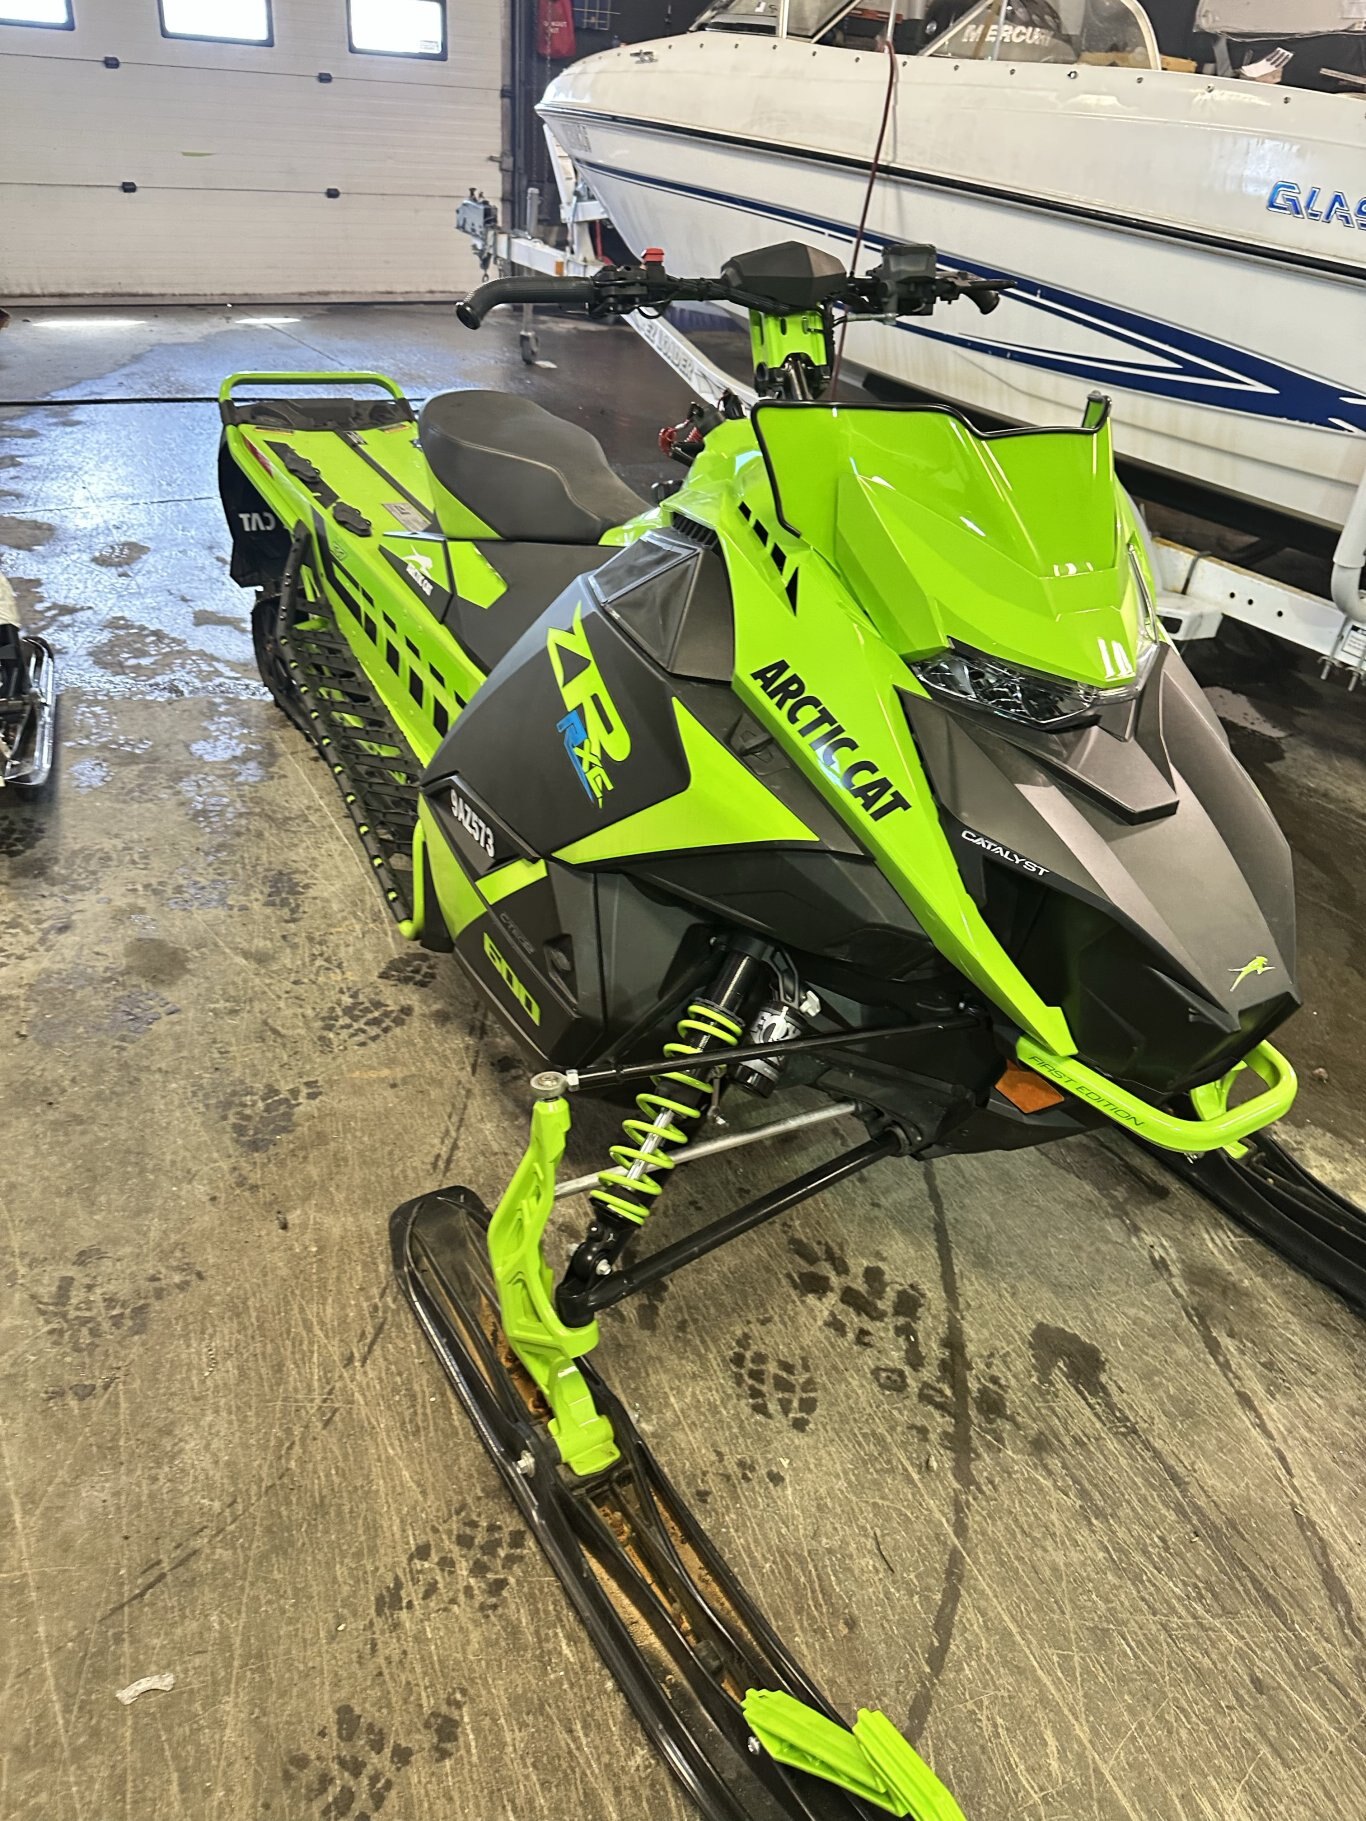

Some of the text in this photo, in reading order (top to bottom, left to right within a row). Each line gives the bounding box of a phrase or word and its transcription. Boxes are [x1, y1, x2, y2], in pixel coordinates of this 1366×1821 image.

[750, 659, 912, 822] ARCTIC CAT
[450, 788, 495, 858] 9AZ573
[961, 830, 1050, 876] CATALYST
[483, 932, 541, 1027] 600
[1027, 1055, 1145, 1127] FIRST EDITION
